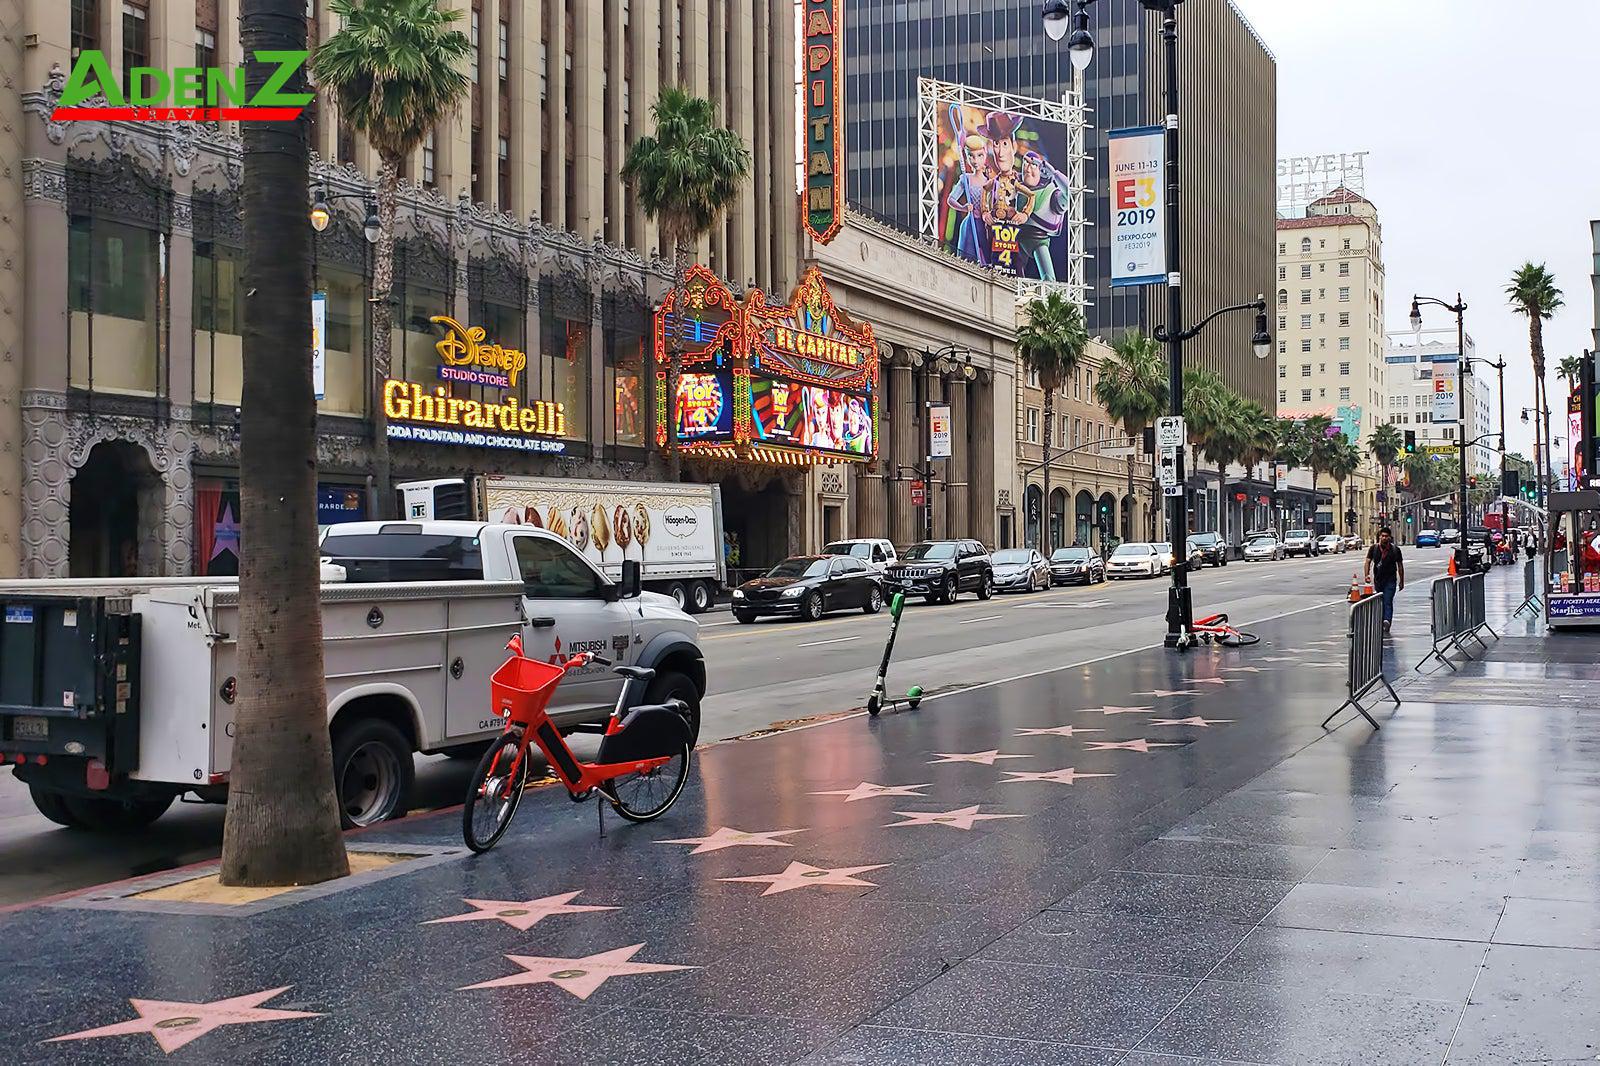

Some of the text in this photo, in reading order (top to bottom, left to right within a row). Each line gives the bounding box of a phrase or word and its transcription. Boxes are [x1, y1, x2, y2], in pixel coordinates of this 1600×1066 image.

[806, 0, 833, 210] APITAN
[1115, 160, 1158, 172] JUNE 11-13
[1117, 178, 1156, 209] E3
[1117, 209, 1156, 226] 2019
[992, 225, 1020, 242] TOY
[1117, 232, 1157, 242] E3EXPO.COM
[999, 249, 1011, 266] 4
[430, 316, 526, 387] Disney
[776, 327, 858, 365] EL CAPITAN
[441, 367, 509, 387] STUDIO STORE
[684, 384, 715, 401] TOY
[384, 379, 567, 436] Ghirardelli
[693, 407, 706, 425] 4
[387, 425, 566, 452] SODA FOUNTAIN AND CHOCOLATE SHOP
[1551, 606, 1584, 615] Starline
[569, 640, 608, 652] MITSUBISHI
[479, 720, 489, 729] CA
